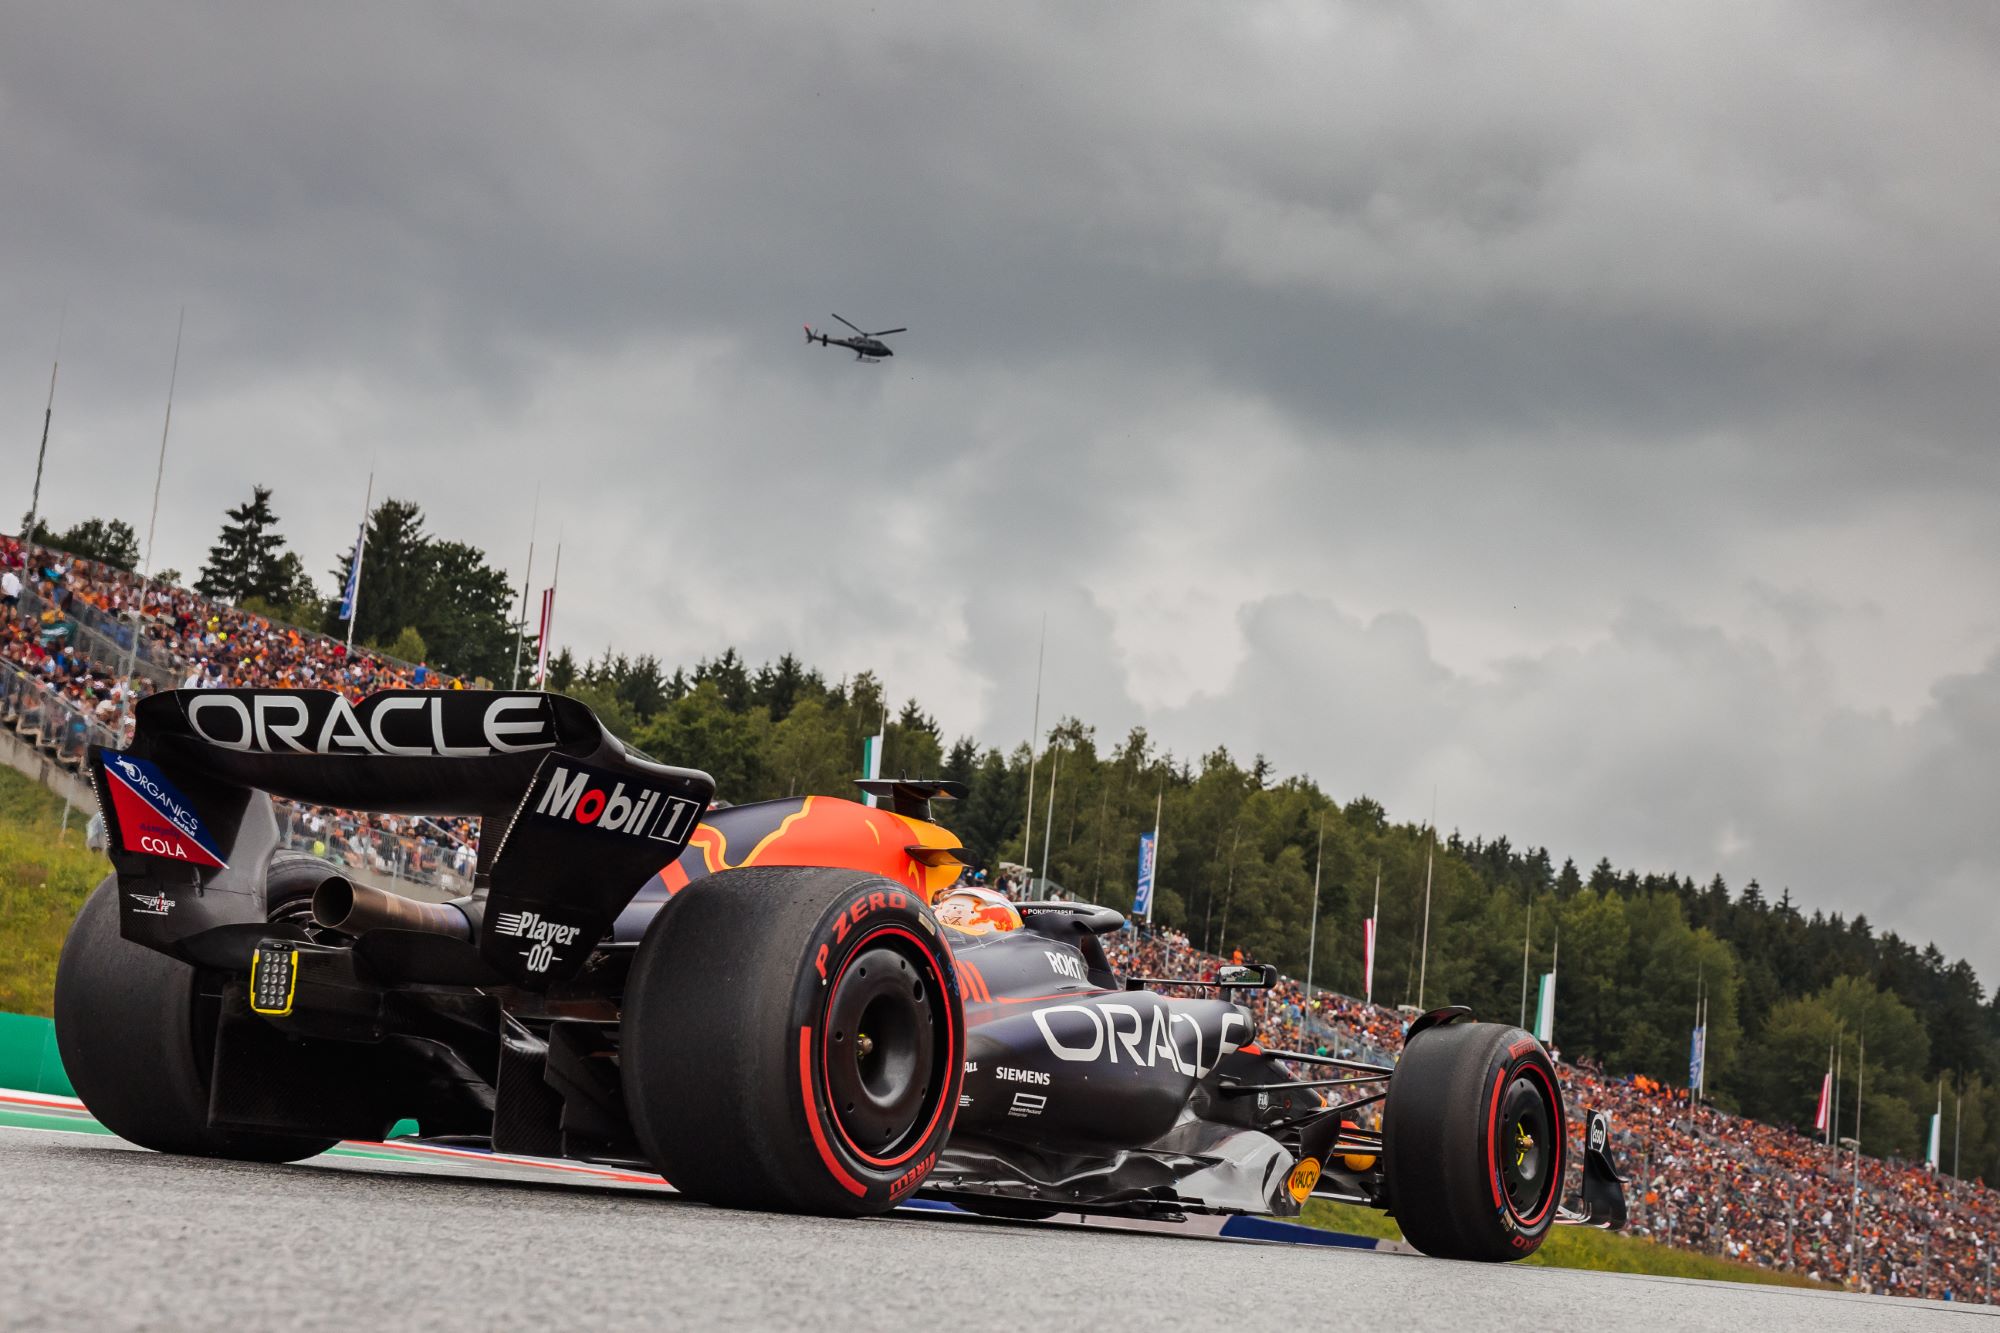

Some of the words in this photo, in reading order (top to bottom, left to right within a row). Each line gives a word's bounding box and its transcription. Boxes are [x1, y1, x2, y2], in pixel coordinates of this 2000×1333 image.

[188, 694, 557, 756] ORACLE
[126, 762, 198, 831] ORGANICS
[536, 767, 661, 836] Mobil
[662, 802, 686, 838] 1
[141, 836, 188, 859] COLA
[515, 911, 581, 947] Player
[815, 944, 829, 979] P
[832, 892, 908, 944] ZERO
[526, 943, 554, 973] 0.0
[1044, 951, 1081, 980] ROKT
[995, 1066, 1051, 1086] SIEMENS
[889, 1152, 936, 1200] PIRELLI
